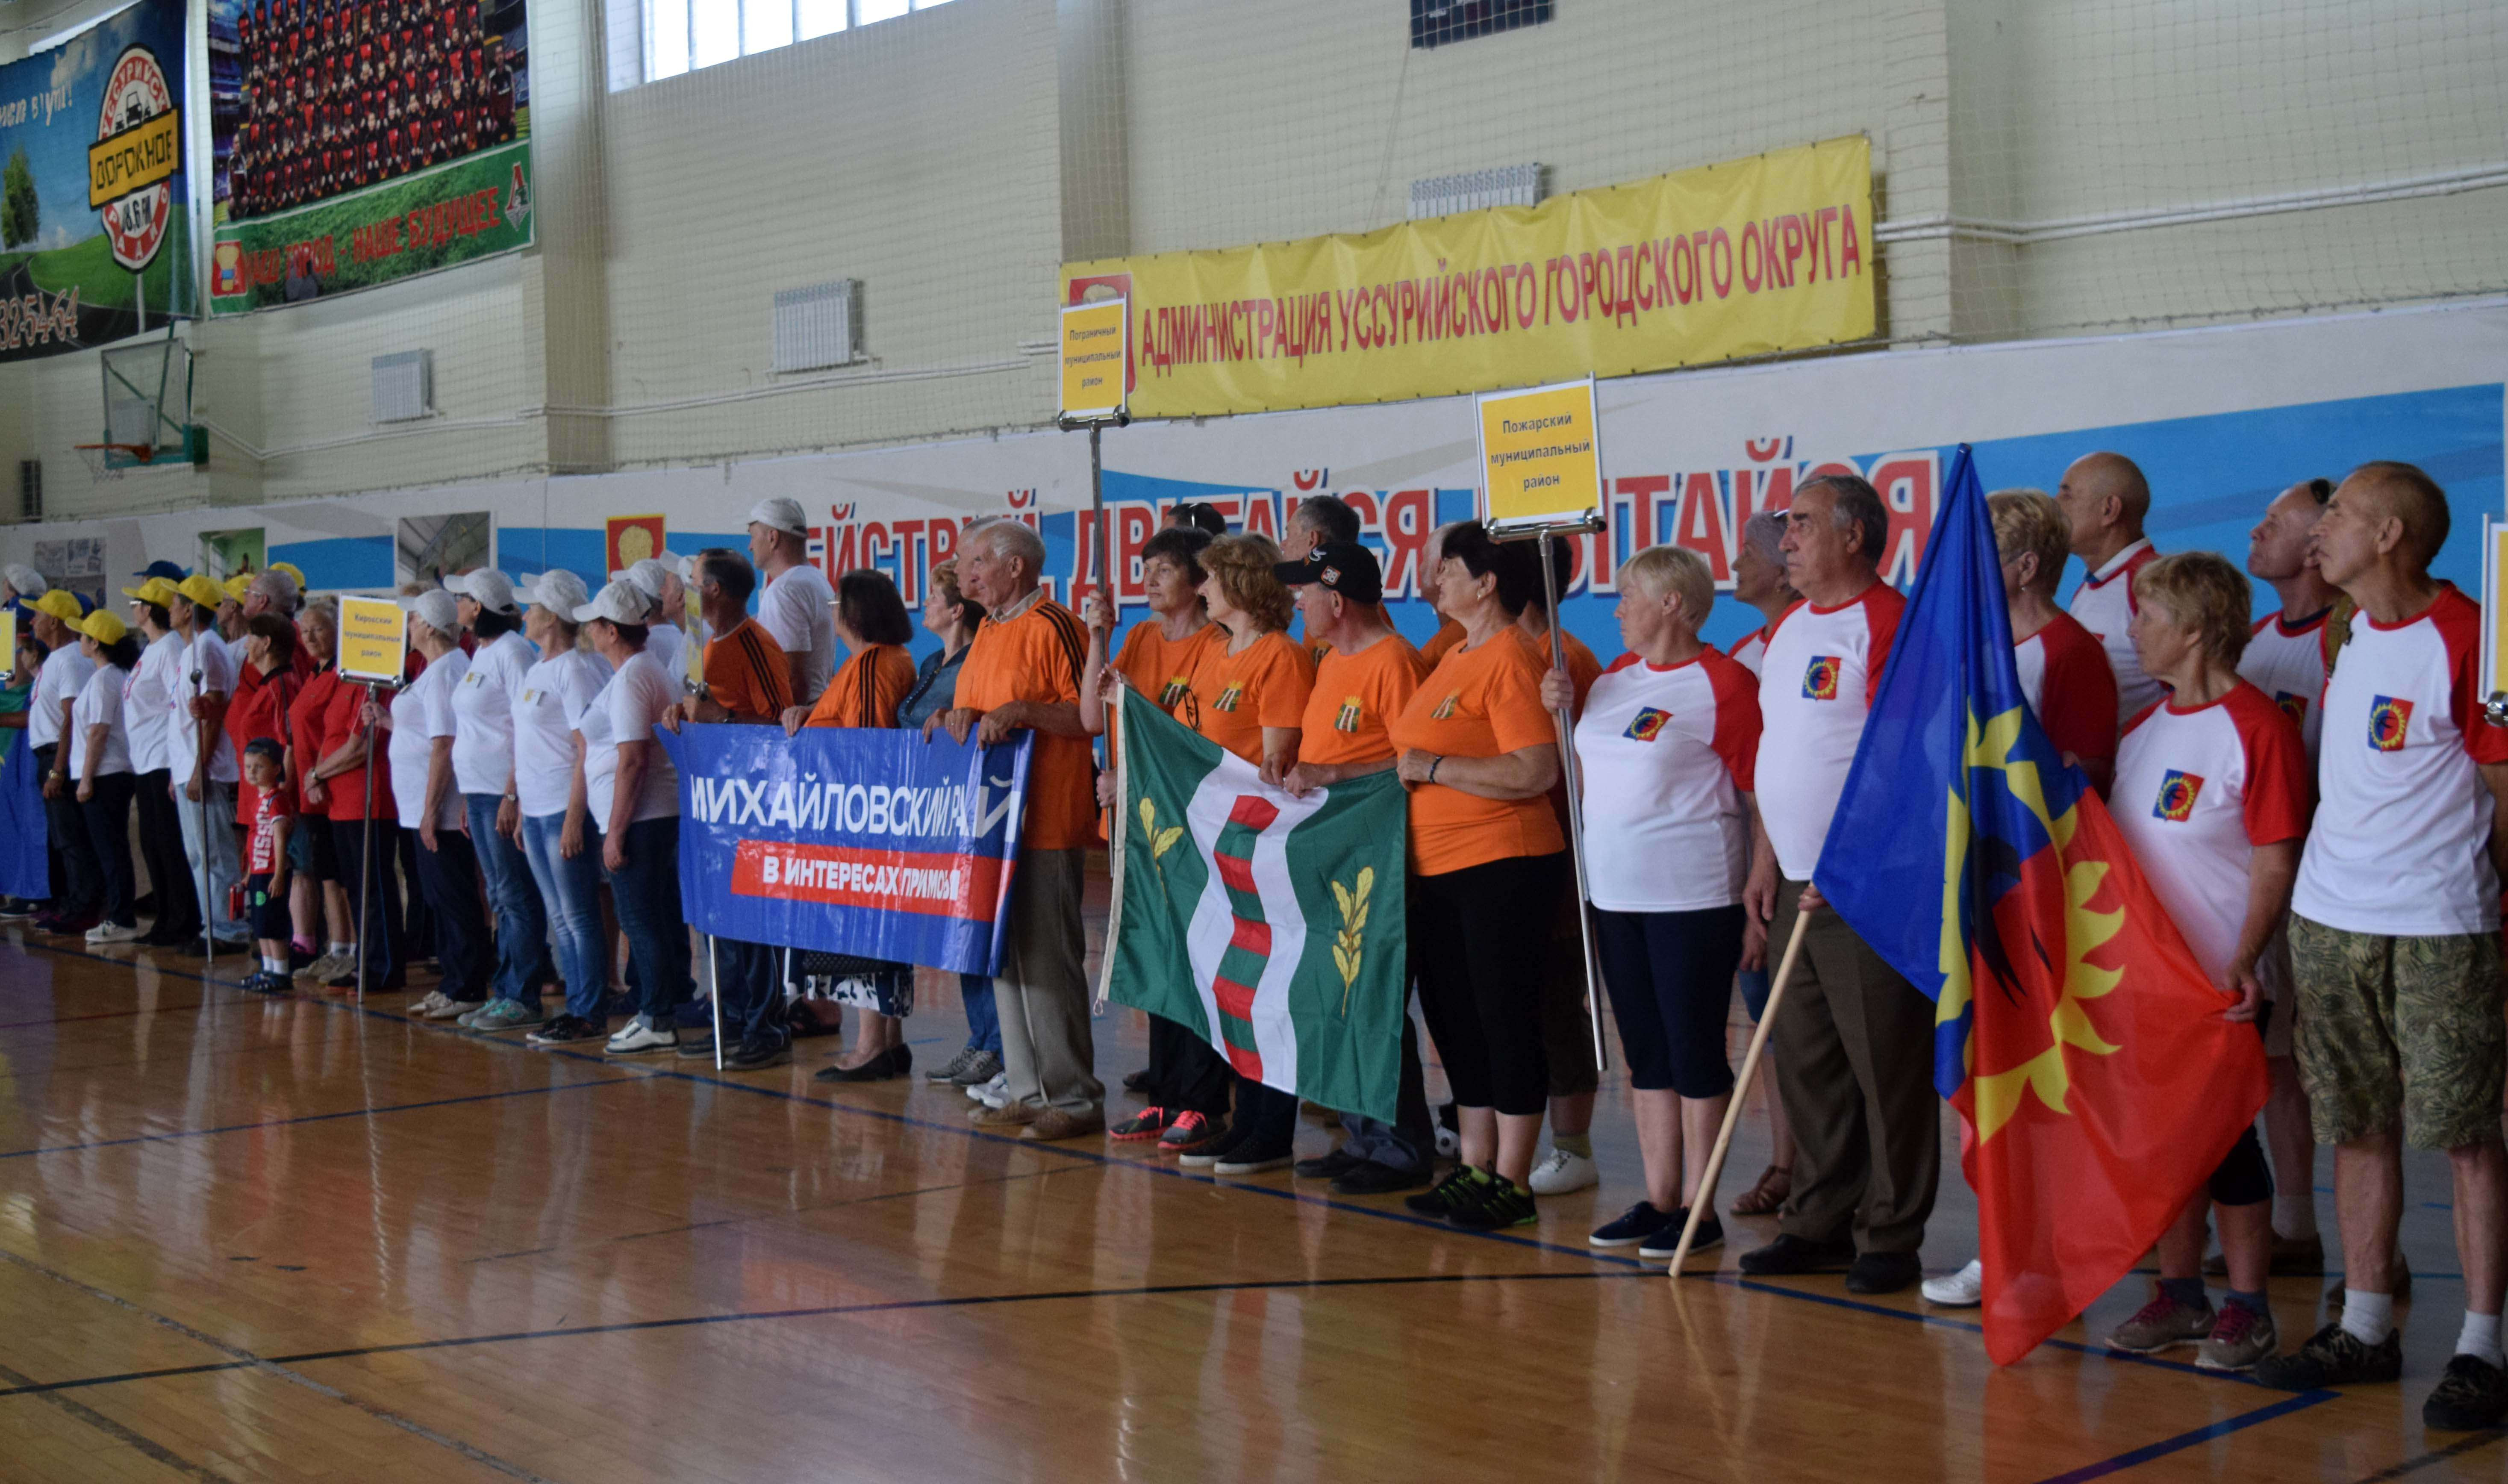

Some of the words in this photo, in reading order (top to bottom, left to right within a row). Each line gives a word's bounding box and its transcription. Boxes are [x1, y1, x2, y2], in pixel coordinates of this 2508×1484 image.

[353, 215, 403, 265] НАШЕ
[408, 186, 501, 250] БУДУЩЕЕ
[1142, 291, 1332, 377] АДМИНИСТРАЦИЯ
[1336, 258, 1537, 352] УССУРИЙСКОГО
[1544, 227, 1732, 329] ГОРОДСКОГО
[1741, 204, 1860, 294] ОКРУГА
[1070, 324, 1116, 342] Пограничный
[1065, 349, 1121, 368] муниципальный
[1502, 411, 1572, 434] Пожарский
[1491, 438, 1590, 467] муниципальный
[1523, 473, 1561, 492] район
[763, 855, 780, 884] В
[784, 857, 900, 896] ИНТЕРЕСАХ
